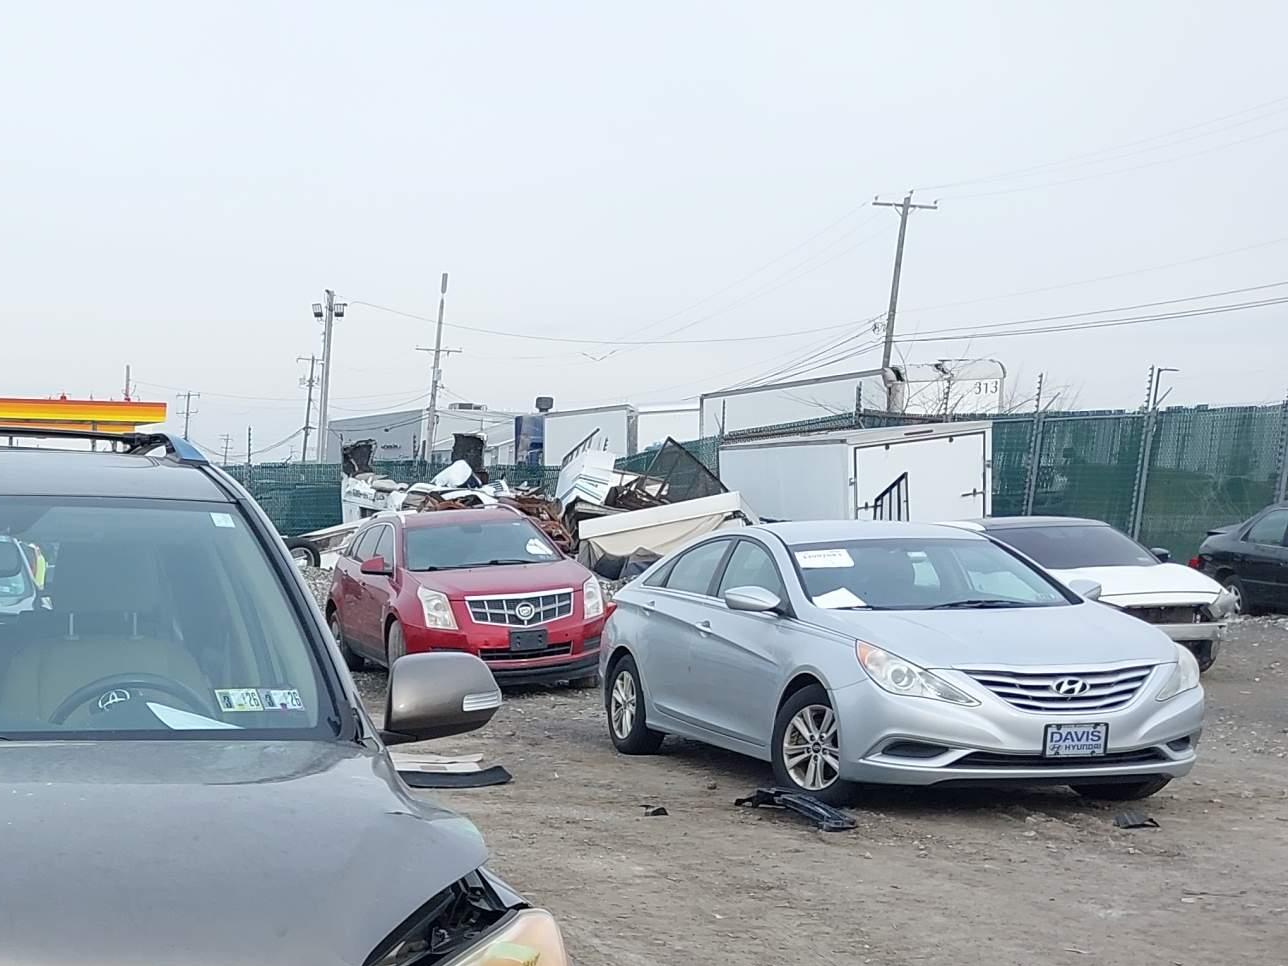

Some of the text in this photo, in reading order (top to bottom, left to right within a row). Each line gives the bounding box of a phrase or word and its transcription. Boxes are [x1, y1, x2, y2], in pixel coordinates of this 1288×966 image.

[974, 380, 998, 395] 313
[1049, 730, 1102, 743] DAVIS
[1064, 743, 1102, 751] HYUNDAI
